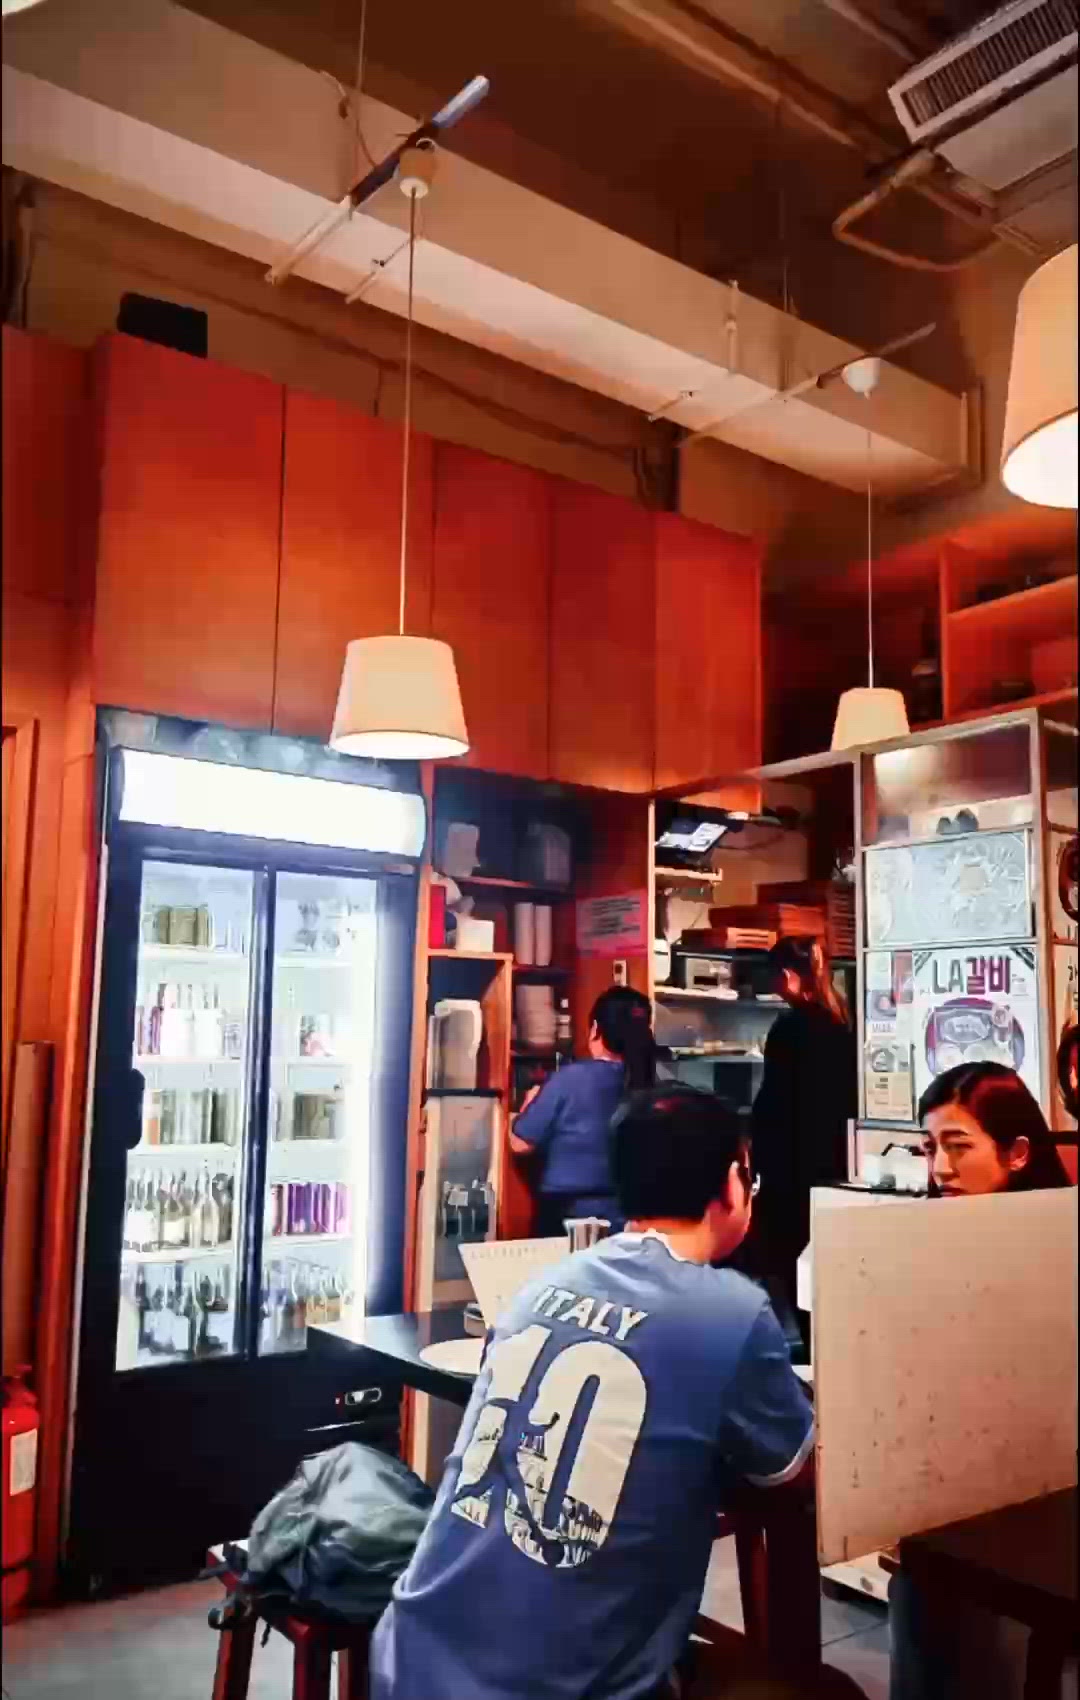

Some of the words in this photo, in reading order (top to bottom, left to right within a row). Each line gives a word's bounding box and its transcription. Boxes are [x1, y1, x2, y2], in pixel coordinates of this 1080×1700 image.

[932, 955, 1010, 995] LA갈비
[532, 1285, 649, 1341] ITALY
[451, 1324, 647, 1569] 10
